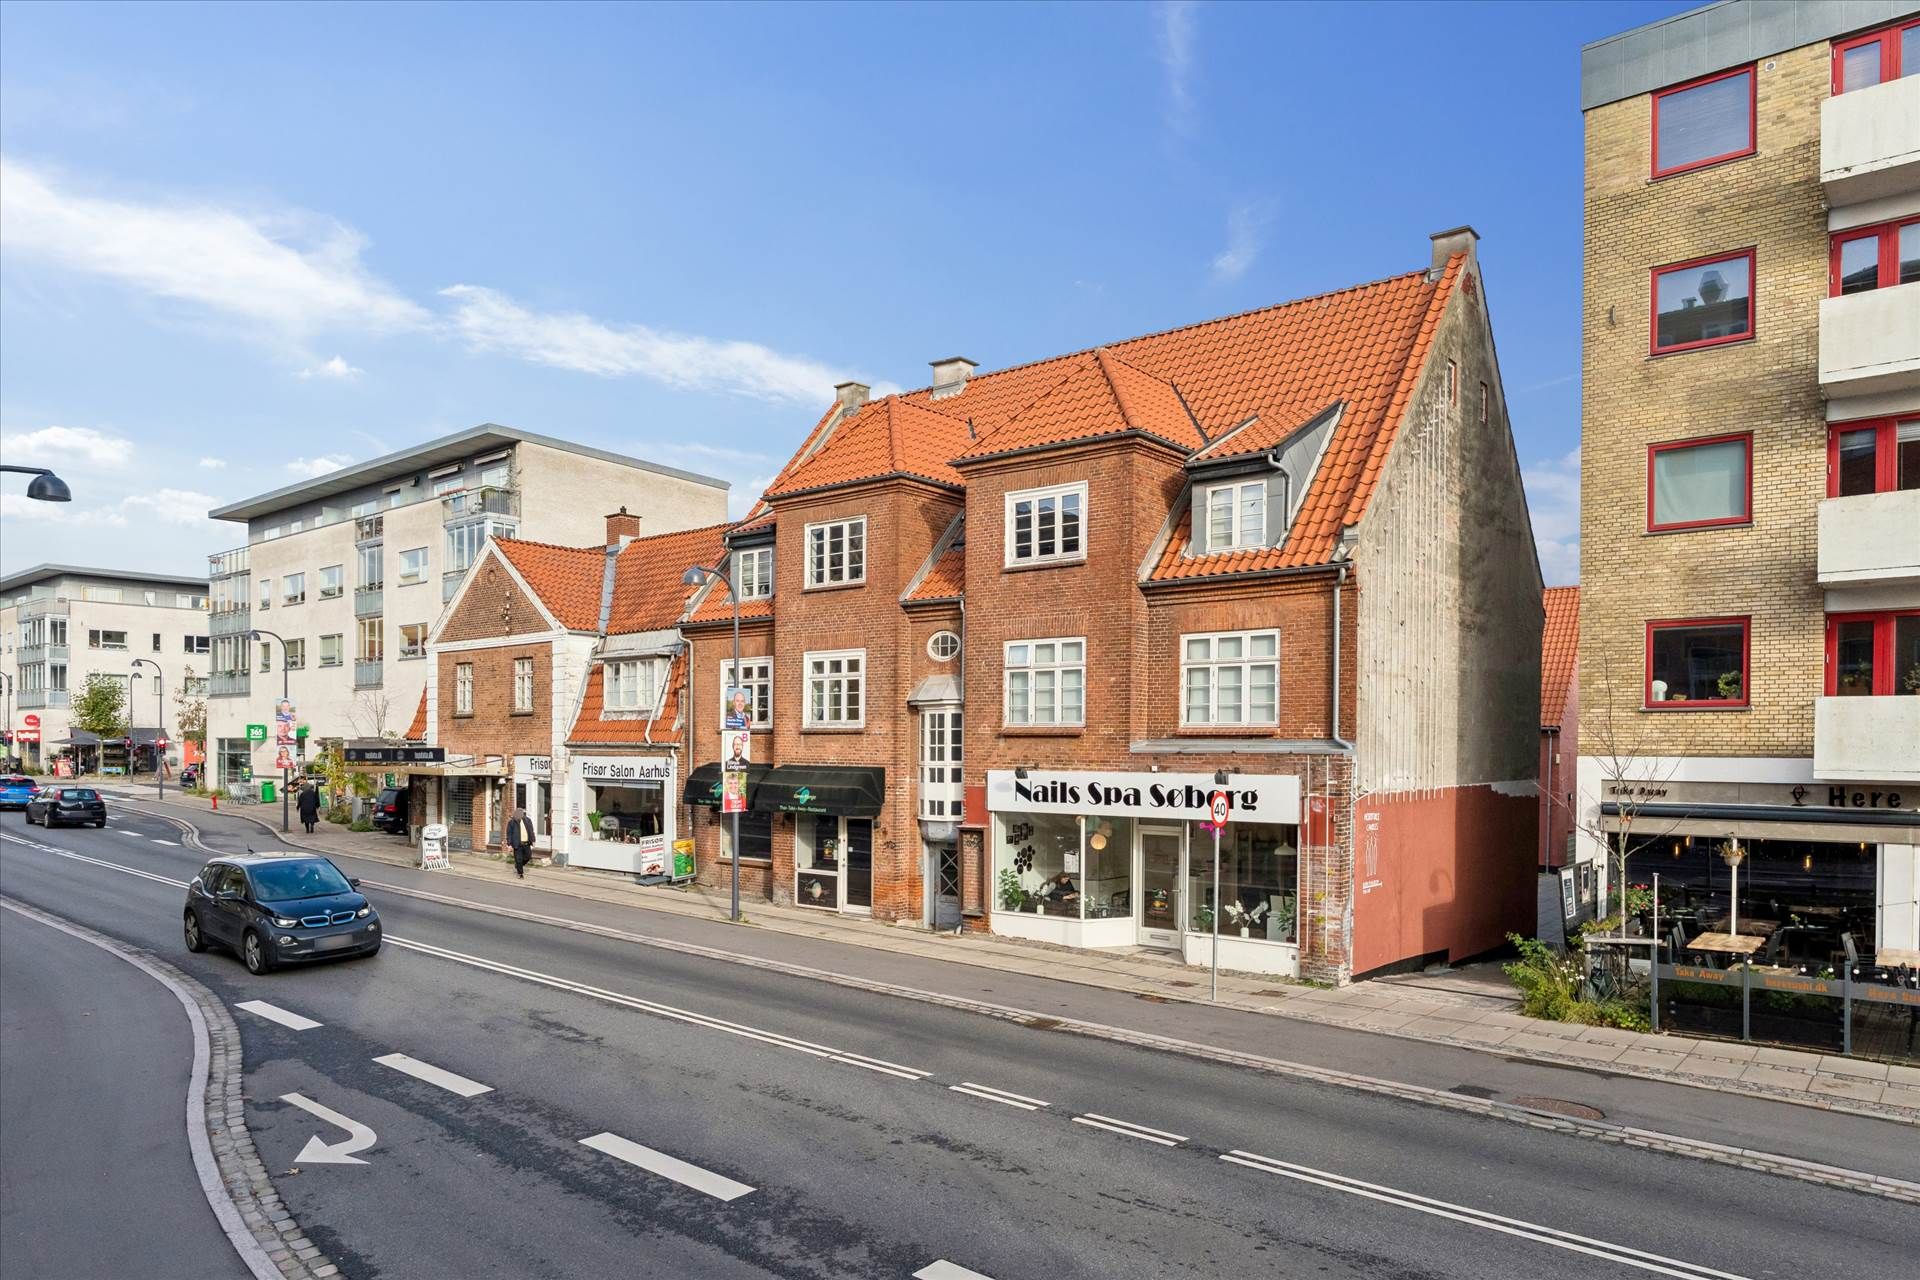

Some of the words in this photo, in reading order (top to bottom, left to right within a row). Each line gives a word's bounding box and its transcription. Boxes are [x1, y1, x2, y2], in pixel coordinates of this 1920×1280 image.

[250, 728, 263, 737] 365
[582, 762, 607, 776] Frisør
[610, 764, 634, 778] Salon
[639, 764, 670, 778] Aarhus
[1015, 780, 1080, 804] Nails
[1087, 782, 1141, 806] Spa
[1829, 786, 1901, 808] Here
[1214, 803, 1226, 816] 40
[1674, 966, 1695, 977] Take
[1698, 970, 1726, 981] Away
